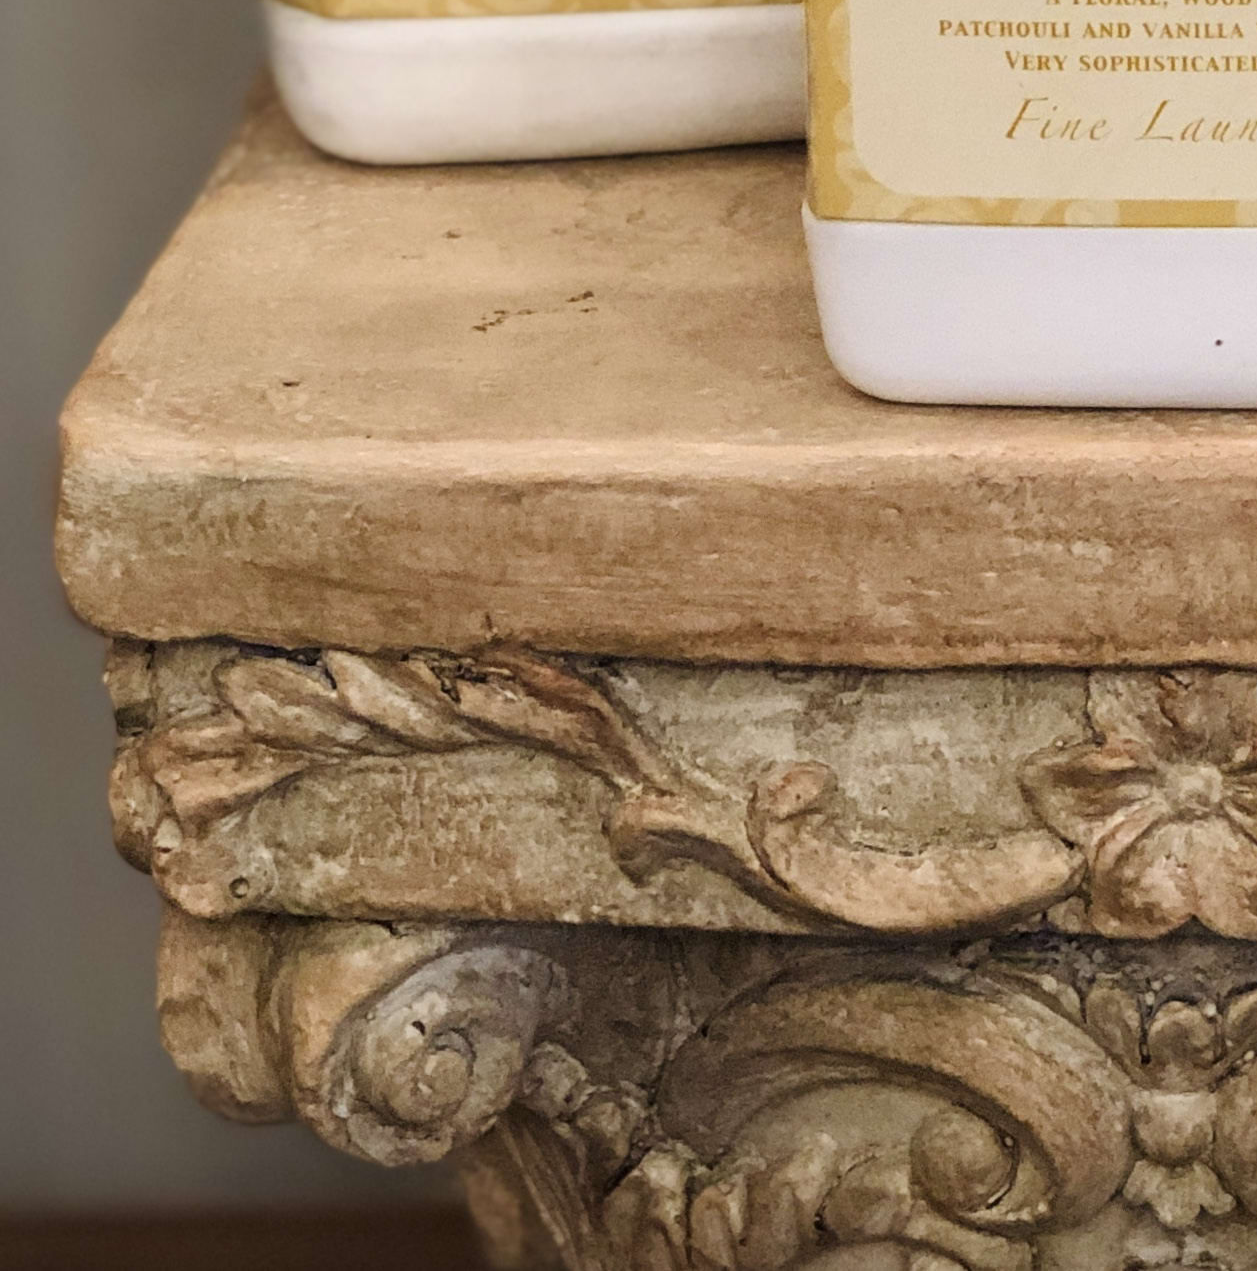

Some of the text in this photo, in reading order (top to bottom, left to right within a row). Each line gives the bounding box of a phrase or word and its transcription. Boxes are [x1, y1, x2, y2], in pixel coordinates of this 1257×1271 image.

[939, 19, 1070, 39] PATCHOULI
[1082, 22, 1132, 39] AND
[1142, 22, 1244, 39] VANILLA
[1004, 50, 1067, 72] VERY
[1005, 96, 1111, 142] Fine
